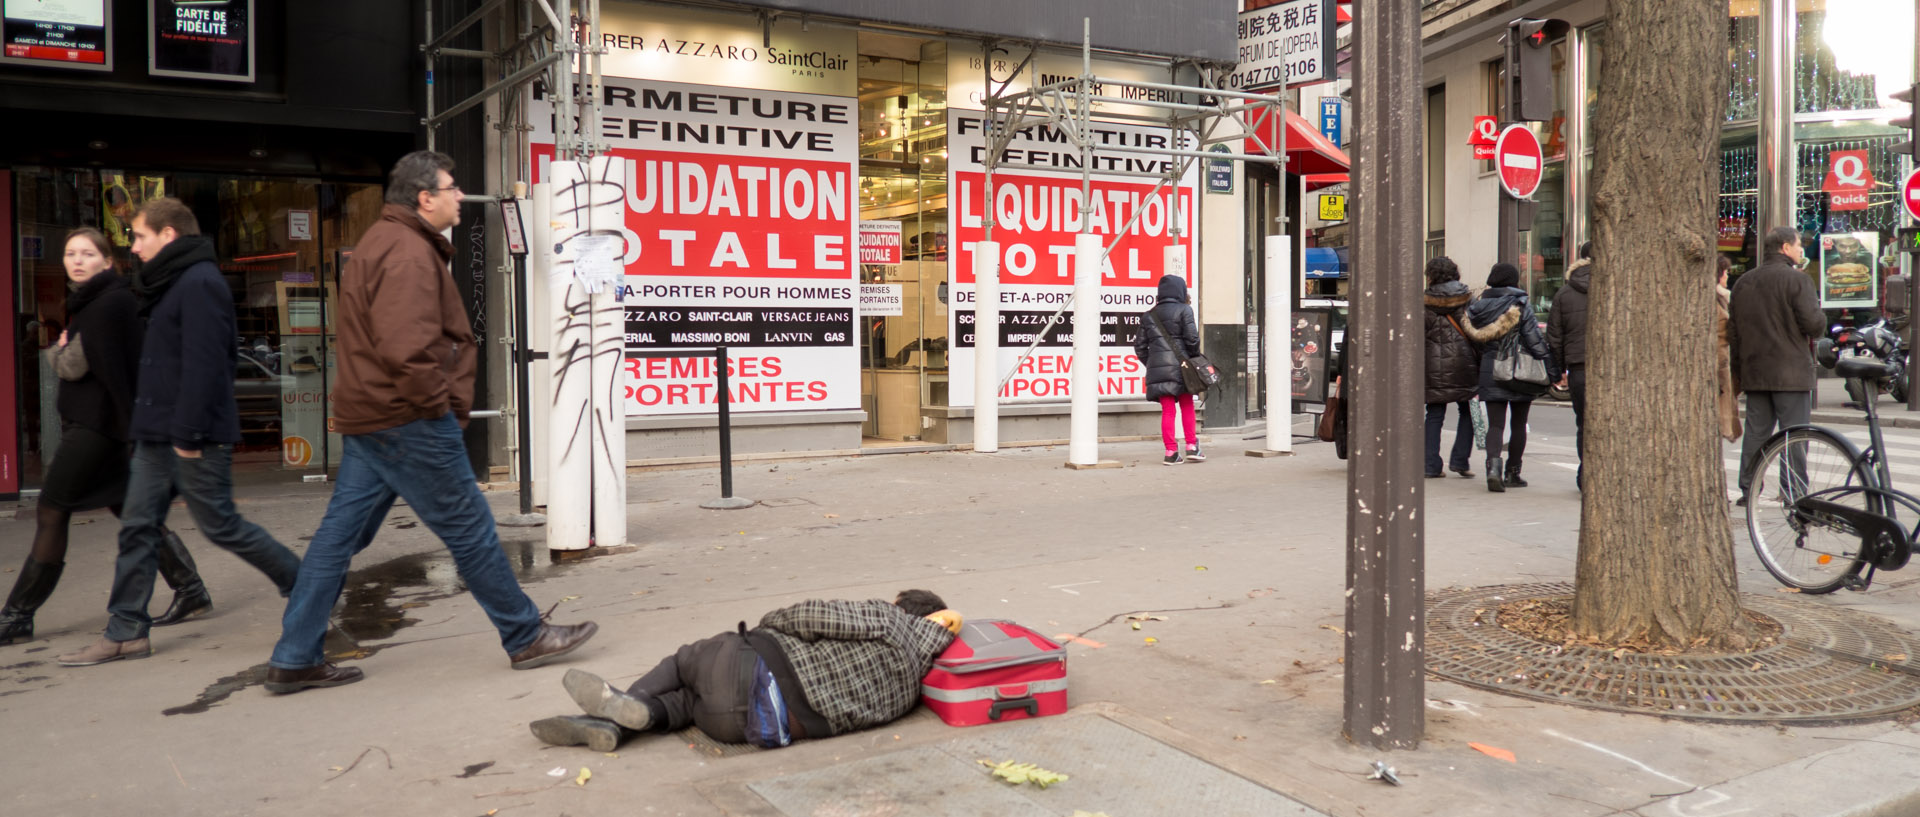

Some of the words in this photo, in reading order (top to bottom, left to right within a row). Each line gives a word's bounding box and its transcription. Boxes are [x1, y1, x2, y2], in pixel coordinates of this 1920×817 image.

[176, 8, 210, 20] CARTE
[213, 11, 227, 21] DE
[176, 20, 227, 35] FIDÉLITÉ
[14, 37, 38, 45] SAMEDI
[46, 40, 76, 48] DIMANCHE
[656, 39, 758, 62] AZZARO
[1240, 42, 1264, 64] RFUM
[1267, 40, 1280, 58] DE
[792, 69, 825, 78] PARIS
[1121, 84, 1188, 104] IMPERIL
[1209, 165, 1231, 173] BOULEVARD
[1834, 155, 1866, 187] Q
[539, 154, 846, 222] UIDATION
[1831, 194, 1866, 205] Quick
[861, 248, 891, 262] TOTALE
[723, 286, 771, 299] POUR
[777, 286, 852, 300] HOMMES
[860, 286, 891, 294] REMISES
[624, 311, 682, 322] ZZARO
[688, 312, 753, 322] SAINT-CLAIR
[761, 312, 812, 322] VERSACE
[814, 313, 850, 322] JEANS
[624, 333, 656, 343] ERIAL
[671, 332, 722, 343] MASSIMO
[724, 332, 750, 343] BONI
[765, 332, 813, 343] LANVIN
[824, 332, 845, 342] GAS
